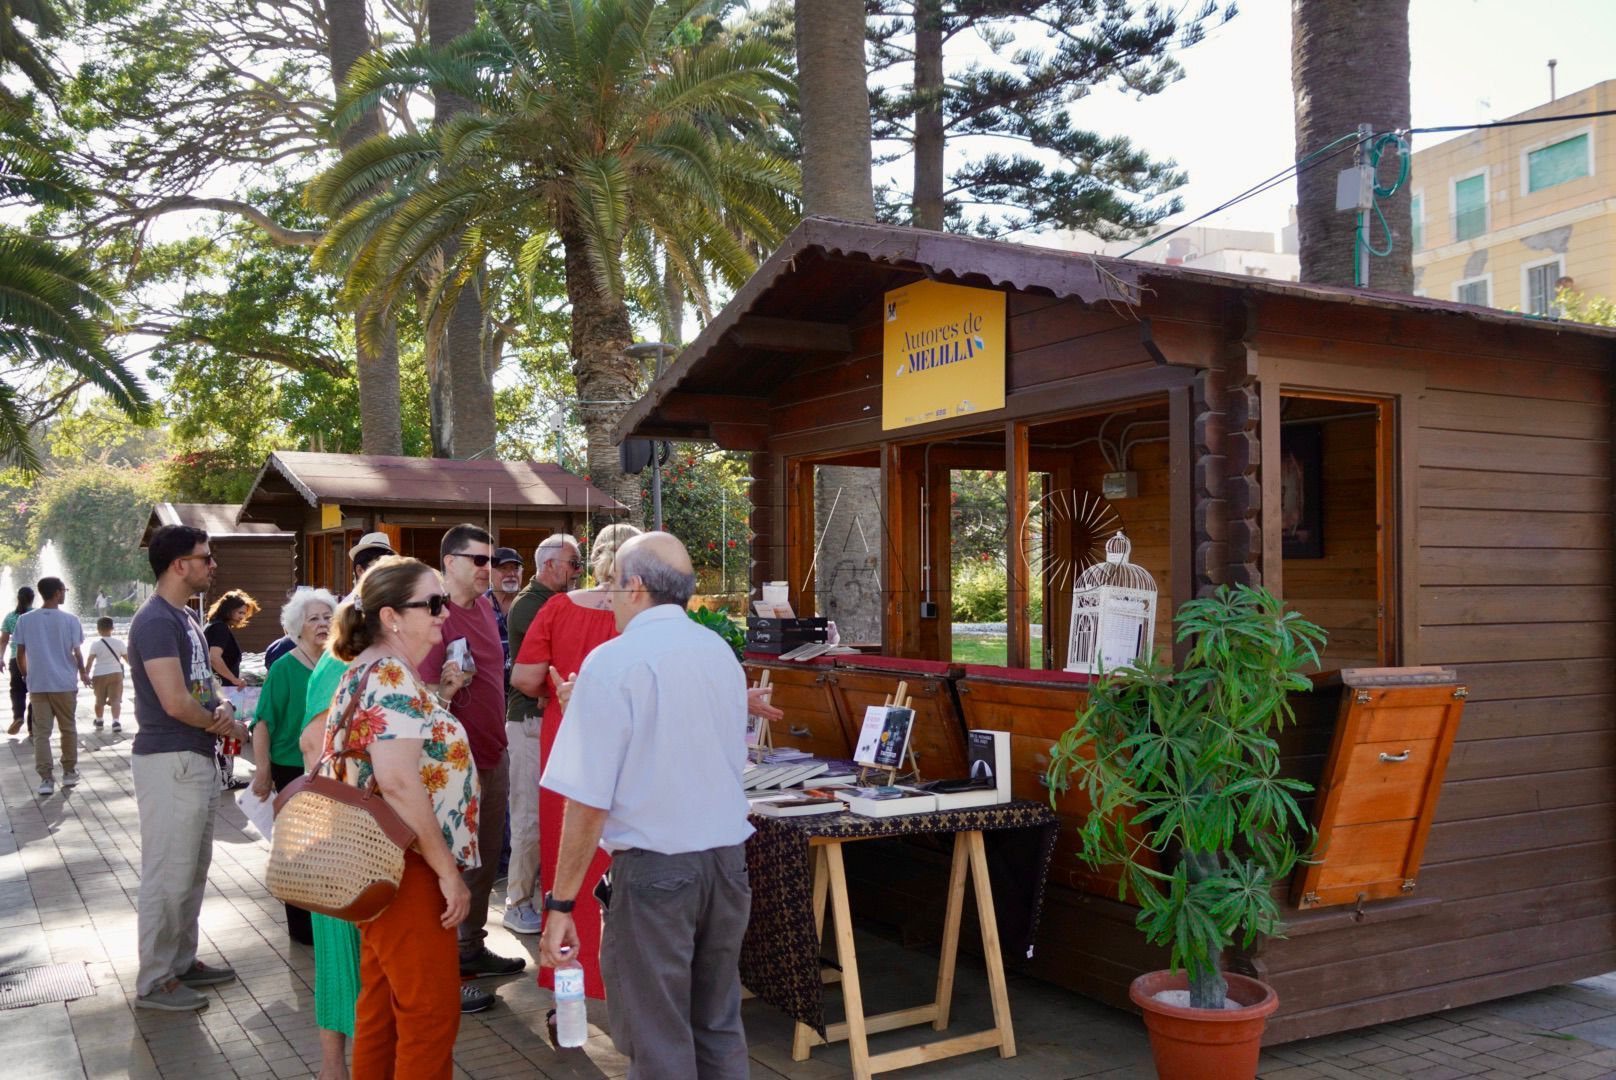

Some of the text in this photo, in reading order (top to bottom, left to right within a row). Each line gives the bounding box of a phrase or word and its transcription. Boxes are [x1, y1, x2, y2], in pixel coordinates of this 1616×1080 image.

[902, 312, 983, 352] Autores de
[908, 338, 974, 374] MELILLA
